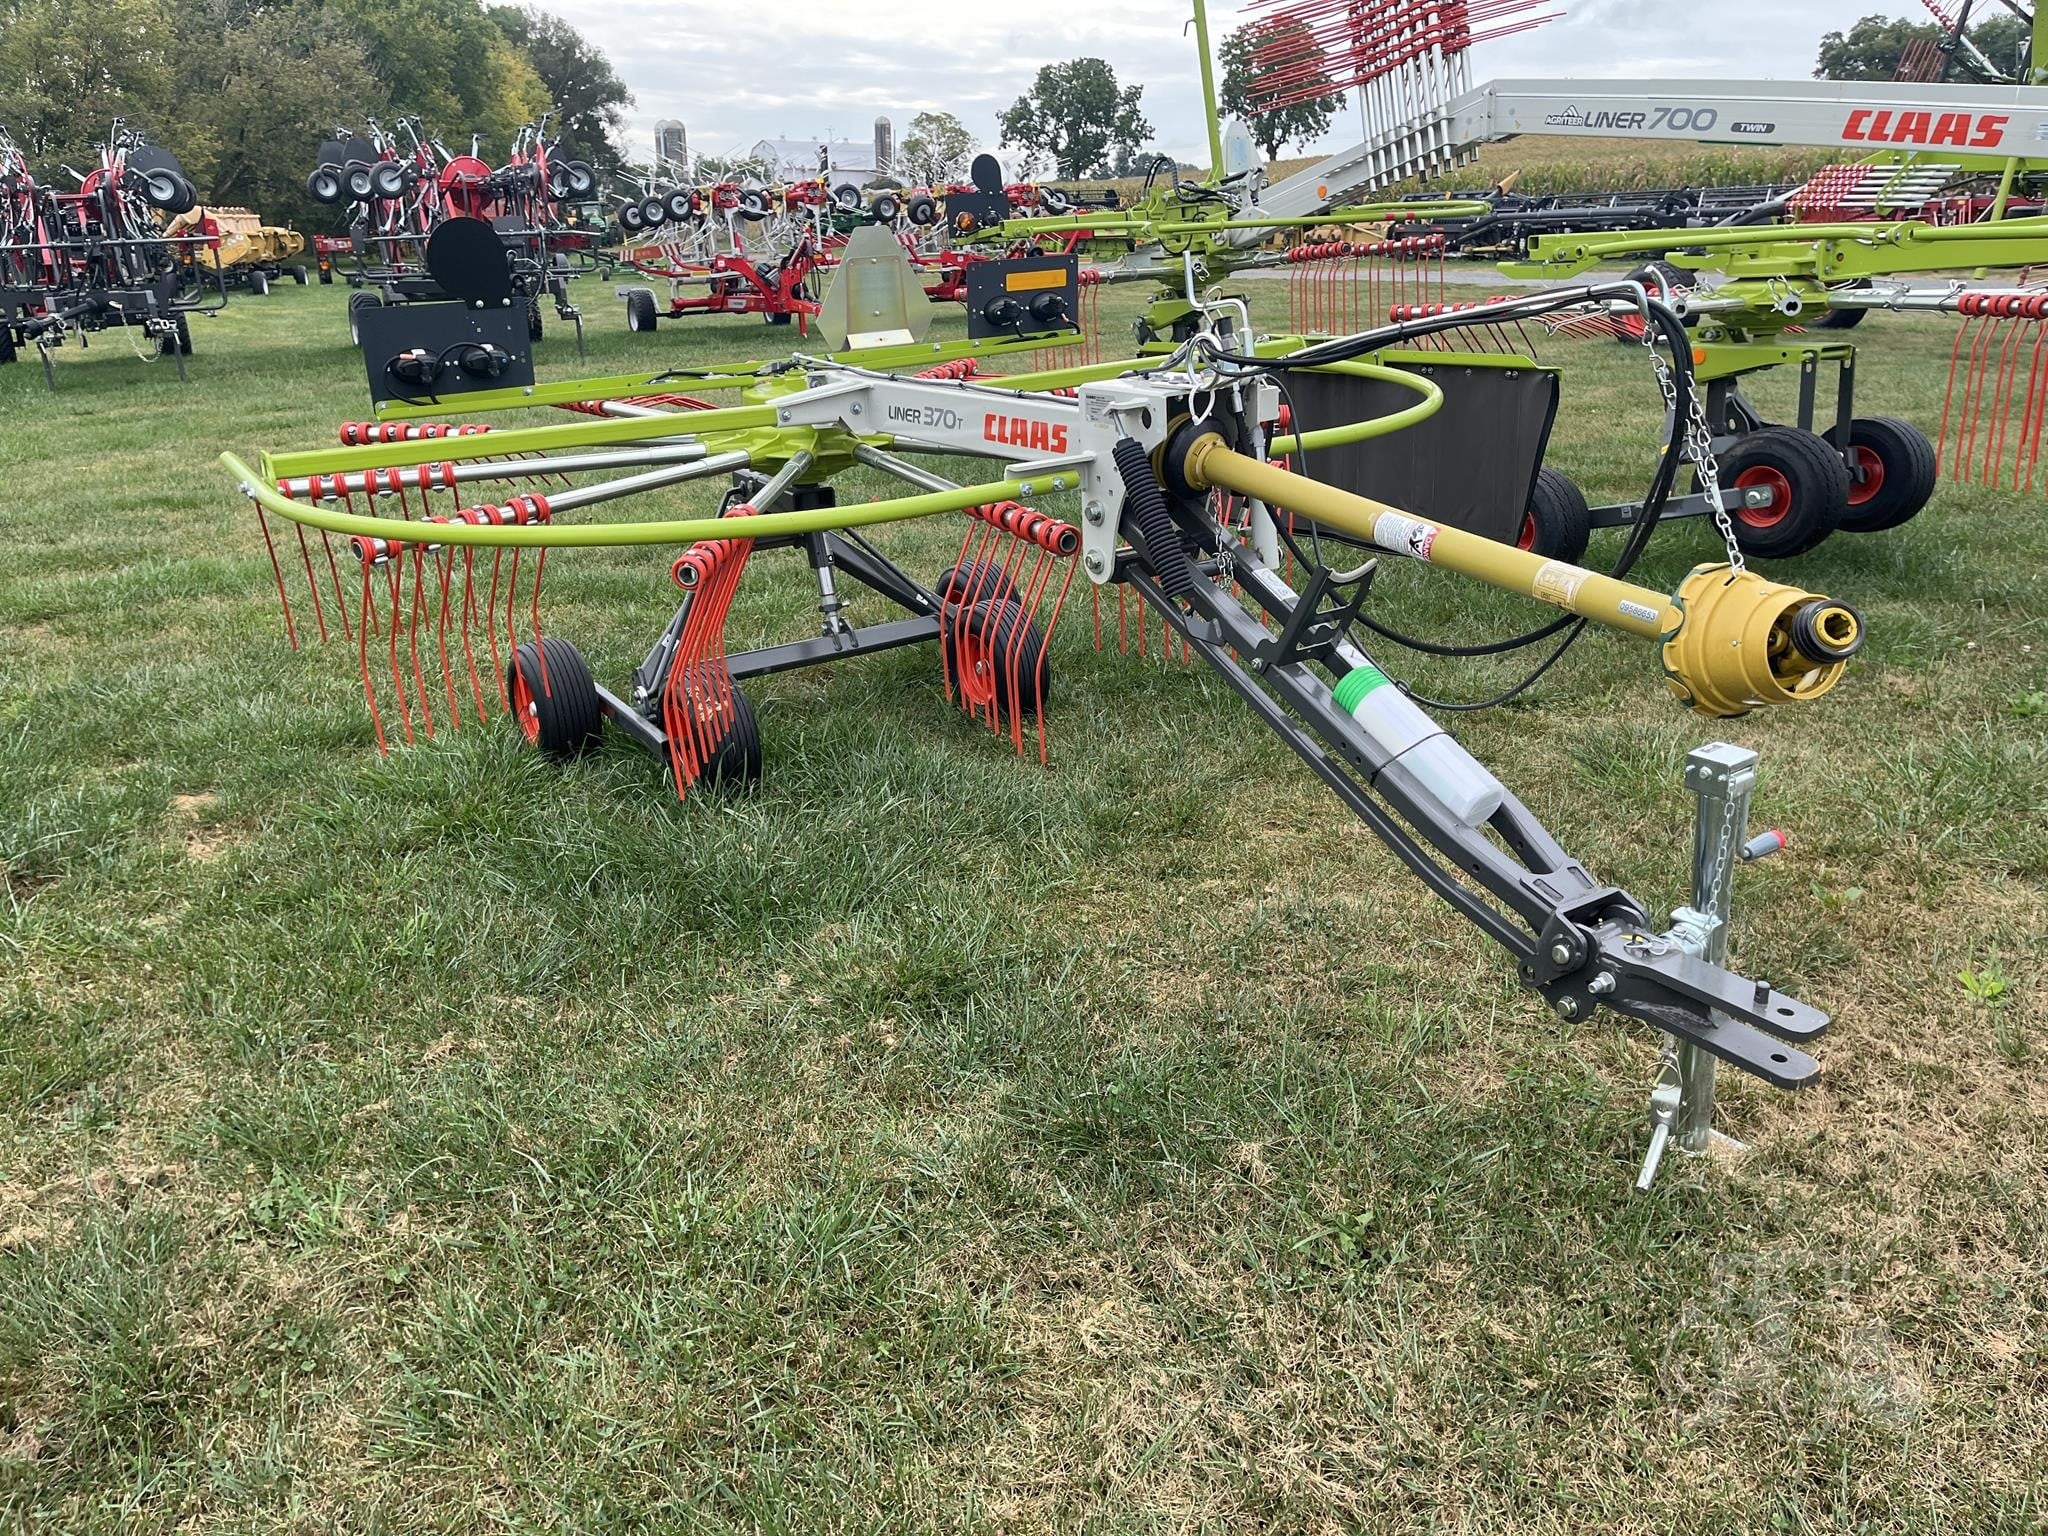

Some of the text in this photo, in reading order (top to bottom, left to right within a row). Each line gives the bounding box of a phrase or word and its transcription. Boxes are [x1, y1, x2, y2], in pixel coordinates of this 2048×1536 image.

[1545, 107, 1767, 133] AGRITEER LINER 700 TWIN
[1841, 109, 2010, 148] CLAAS
[888, 405, 921, 424] LINER
[984, 413, 1068, 454] CLAAS
